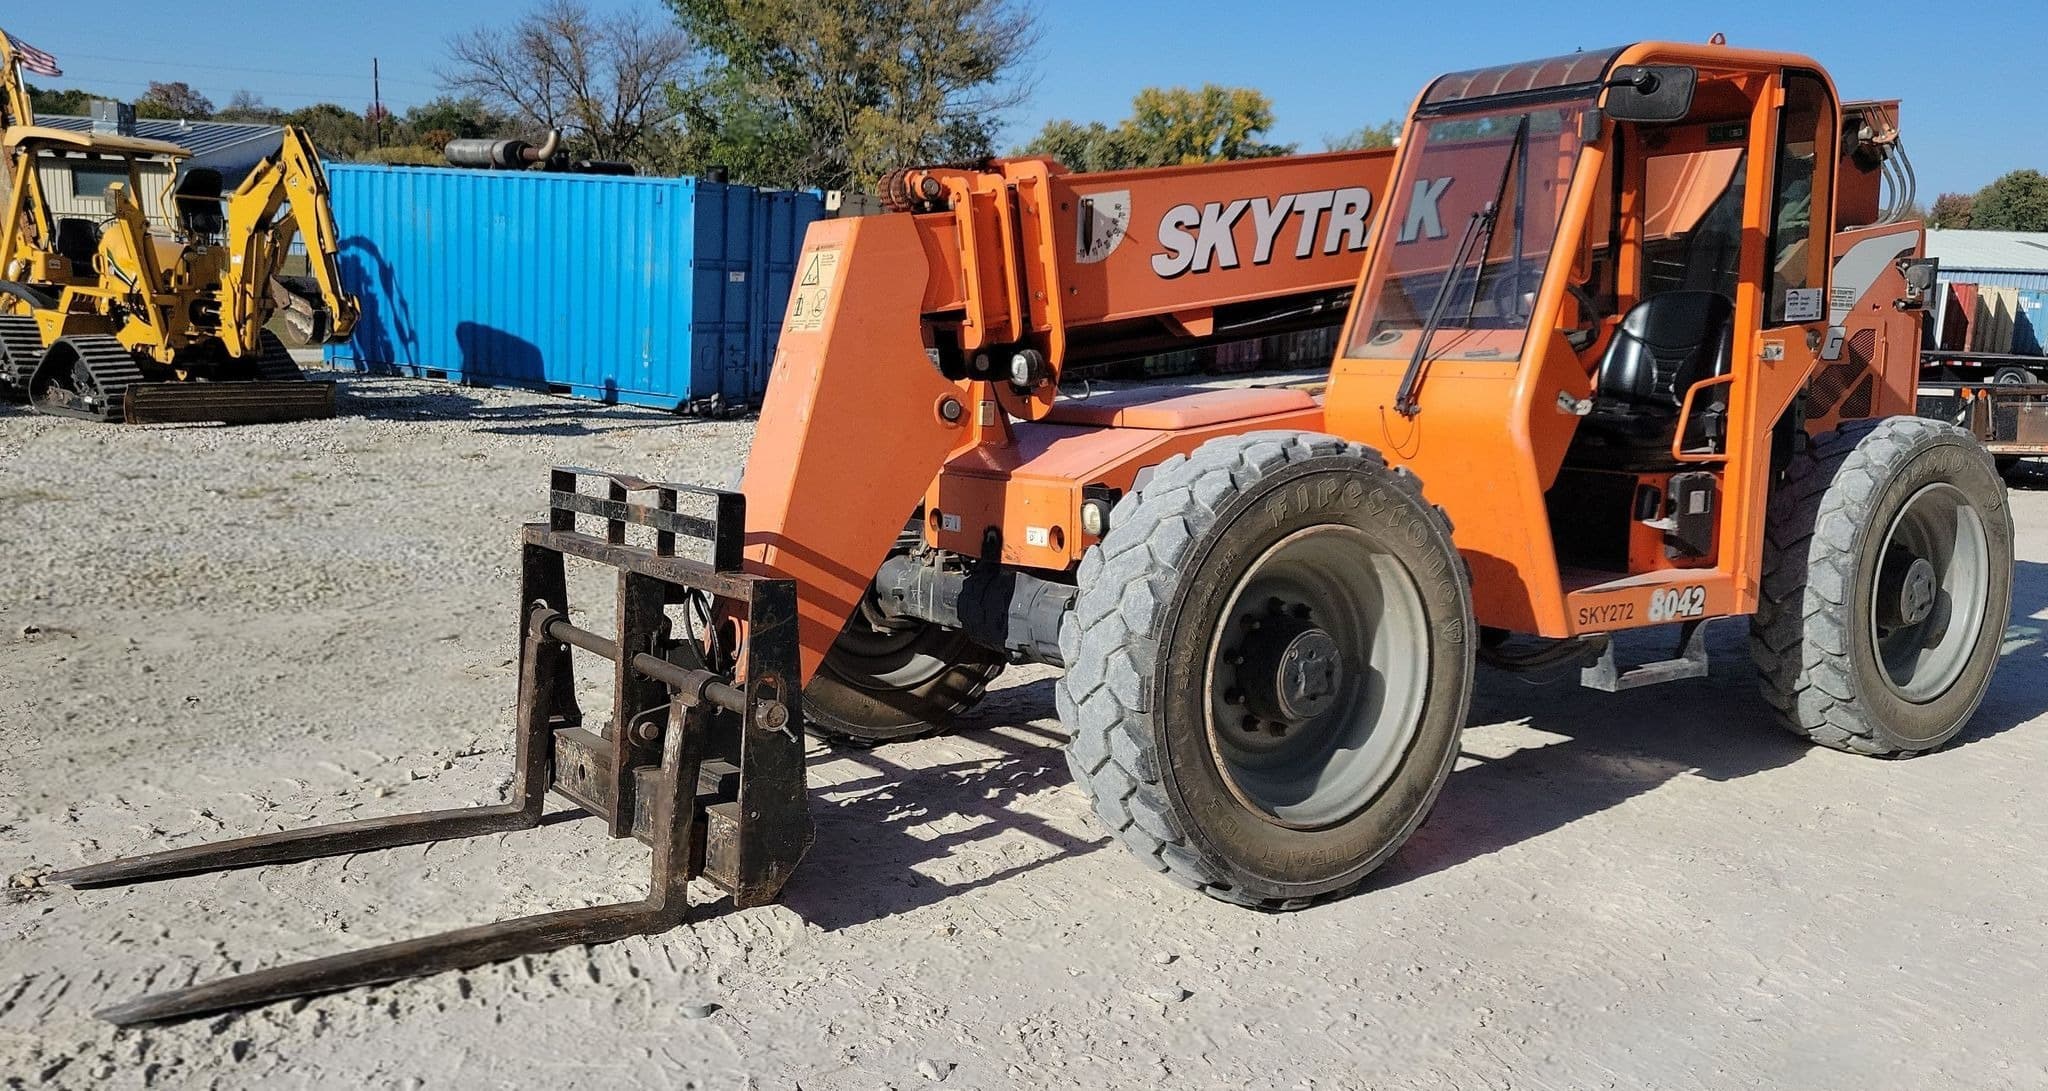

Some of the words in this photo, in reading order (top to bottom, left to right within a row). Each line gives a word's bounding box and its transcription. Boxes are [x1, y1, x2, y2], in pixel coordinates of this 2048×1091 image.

[1151, 177, 1453, 279] SKYTRK
[1578, 602, 1634, 626] SKY272
[1647, 585, 1707, 622] 8042
